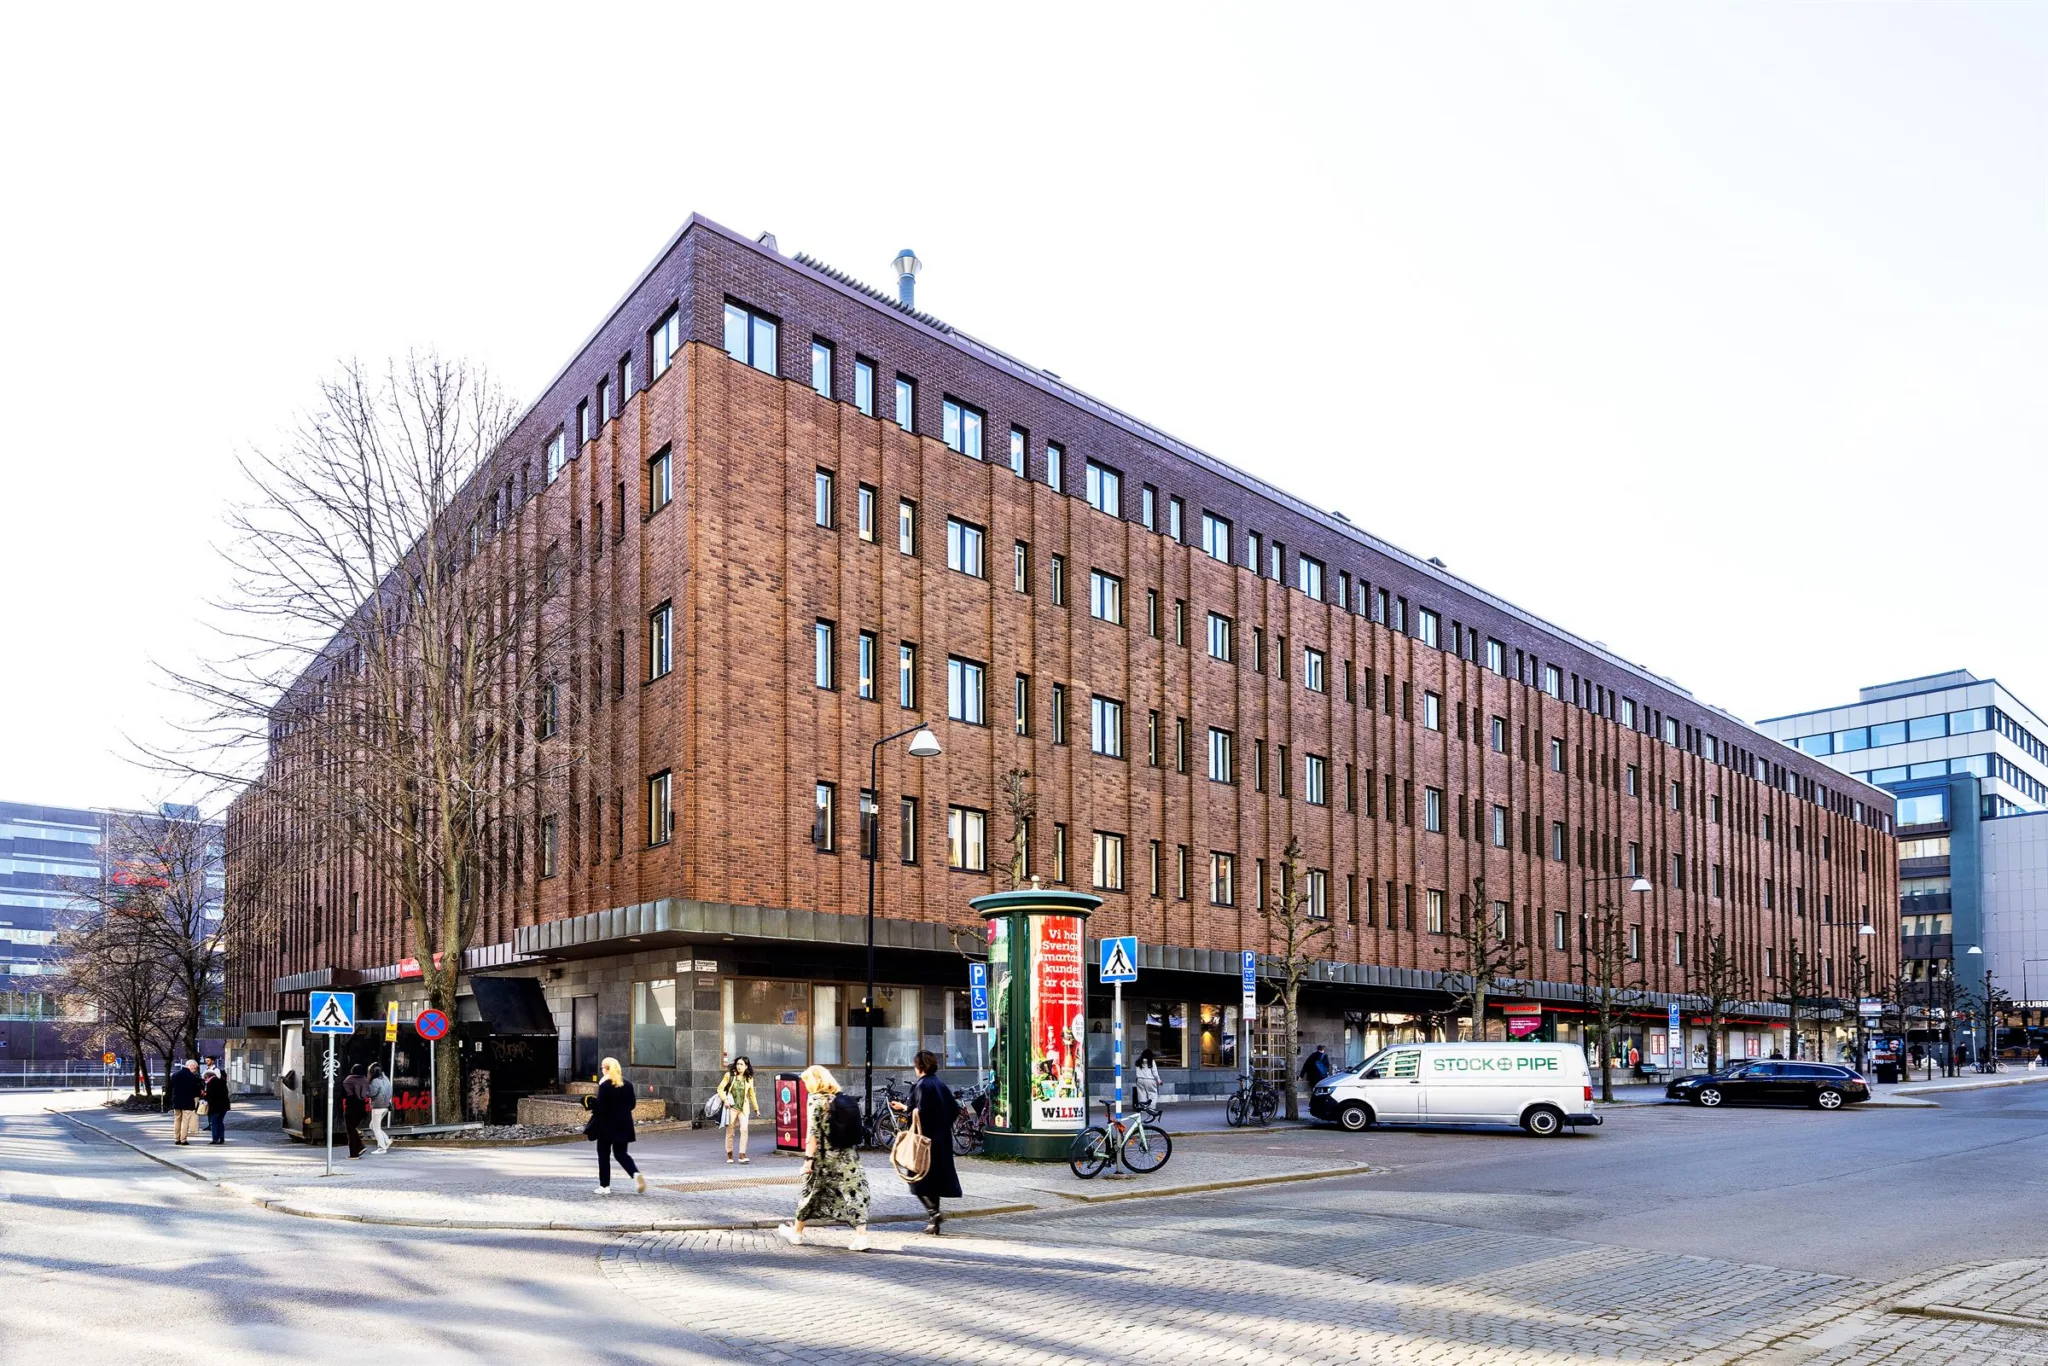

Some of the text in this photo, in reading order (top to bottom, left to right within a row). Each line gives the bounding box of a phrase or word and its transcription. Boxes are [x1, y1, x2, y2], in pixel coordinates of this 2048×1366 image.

[1048, 929, 1061, 939] Vi
[1246, 952, 1253, 967] P
[974, 966, 983, 985] P
[1671, 1004, 1677, 1013] P
[1434, 1058, 1558, 1071] STOCK PIPE
